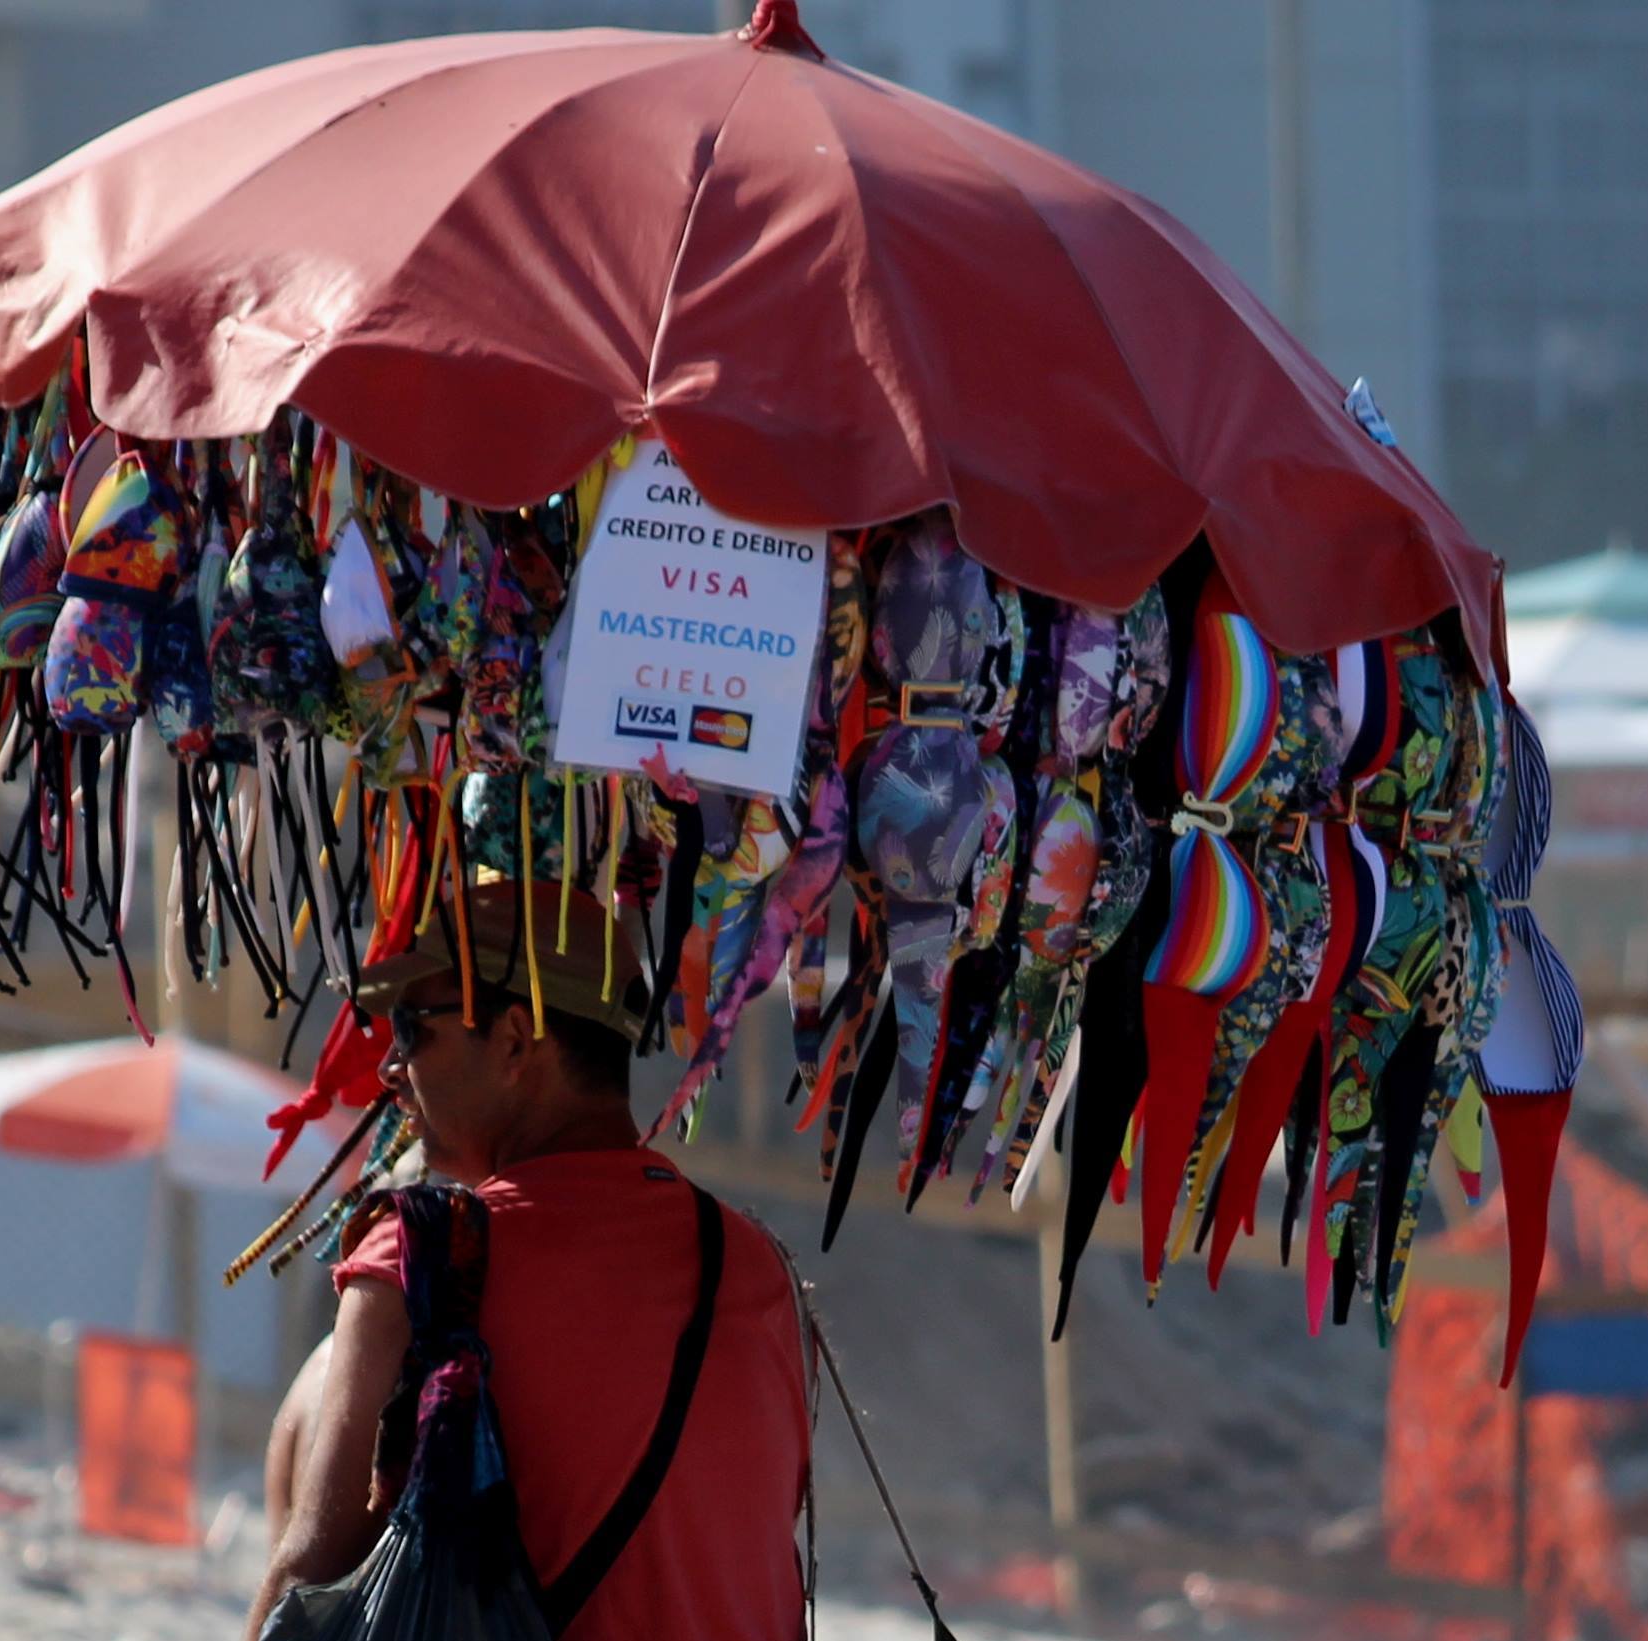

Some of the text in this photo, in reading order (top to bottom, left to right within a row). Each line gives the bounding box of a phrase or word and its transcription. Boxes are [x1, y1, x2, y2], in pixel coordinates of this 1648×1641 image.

[607, 517, 815, 563] CREDITO E DEBITO
[662, 565, 749, 599] VISA
[599, 609, 797, 658] MASTERCARD
[635, 663, 747, 700] CIELO
[625, 703, 676, 727] VISA
